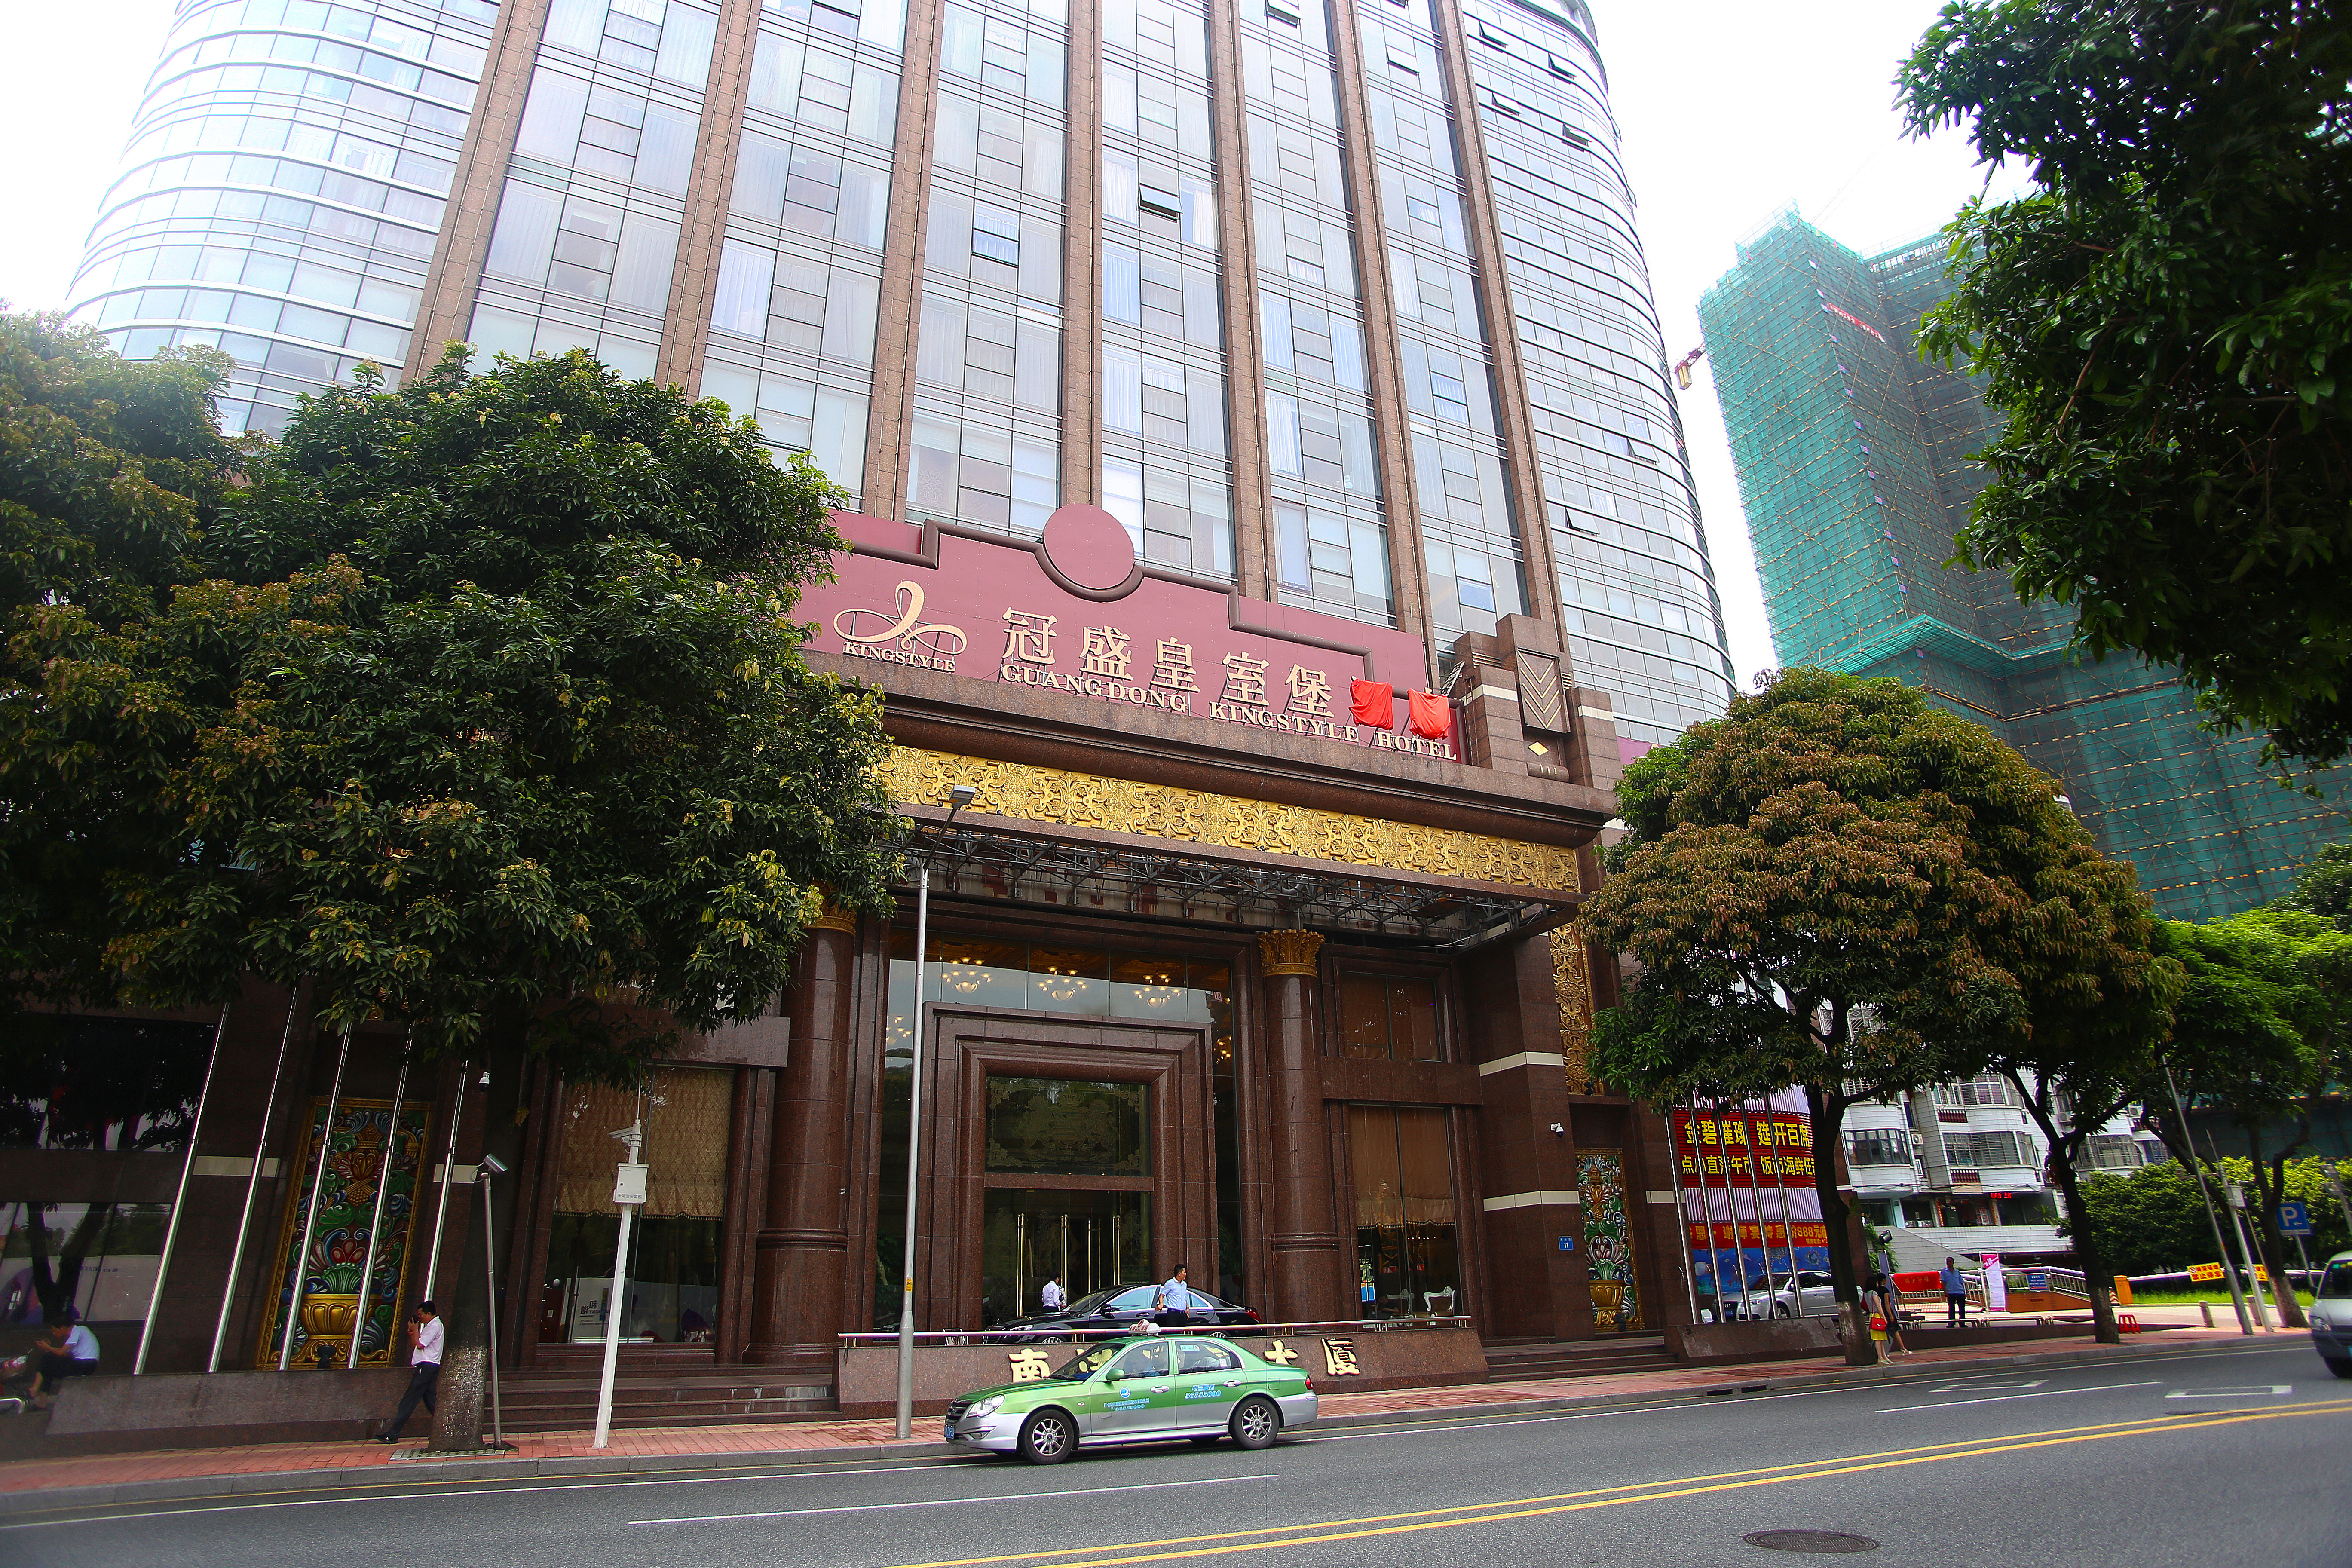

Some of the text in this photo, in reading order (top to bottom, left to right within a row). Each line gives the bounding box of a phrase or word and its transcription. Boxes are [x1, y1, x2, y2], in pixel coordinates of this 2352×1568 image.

[843, 641, 956, 672] KINGSTYLE
[1002, 606, 1451, 739] 冠盛皇室堡
[1002, 665, 1457, 760] GUANGDONG KINGSTYLE HOTEL
[2280, 1207, 2298, 1227] P
